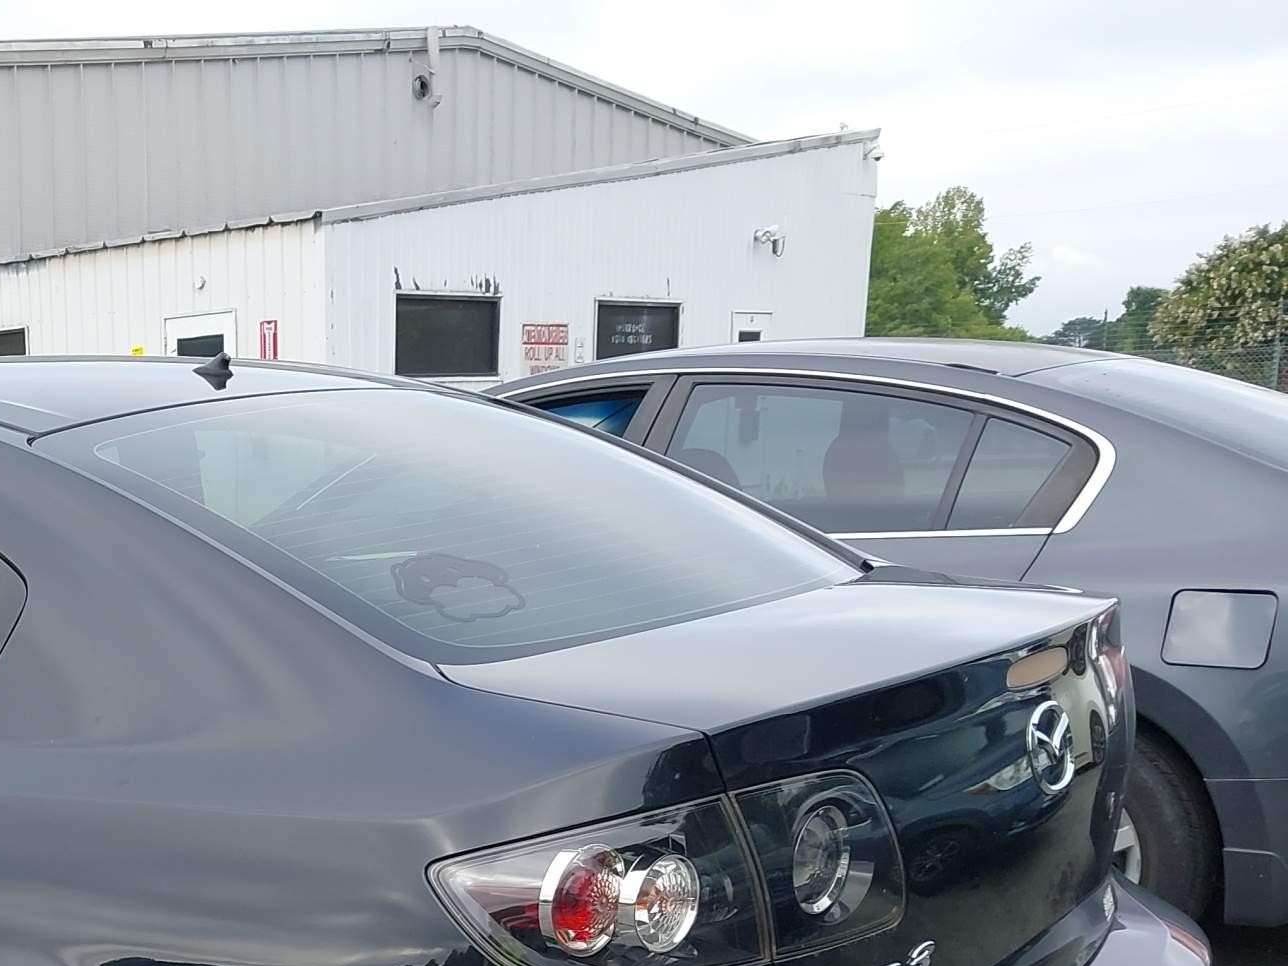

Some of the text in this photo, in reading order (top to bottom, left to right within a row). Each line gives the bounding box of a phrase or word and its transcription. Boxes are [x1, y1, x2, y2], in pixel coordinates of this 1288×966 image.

[524, 346, 566, 361] ROLL UP ALL
